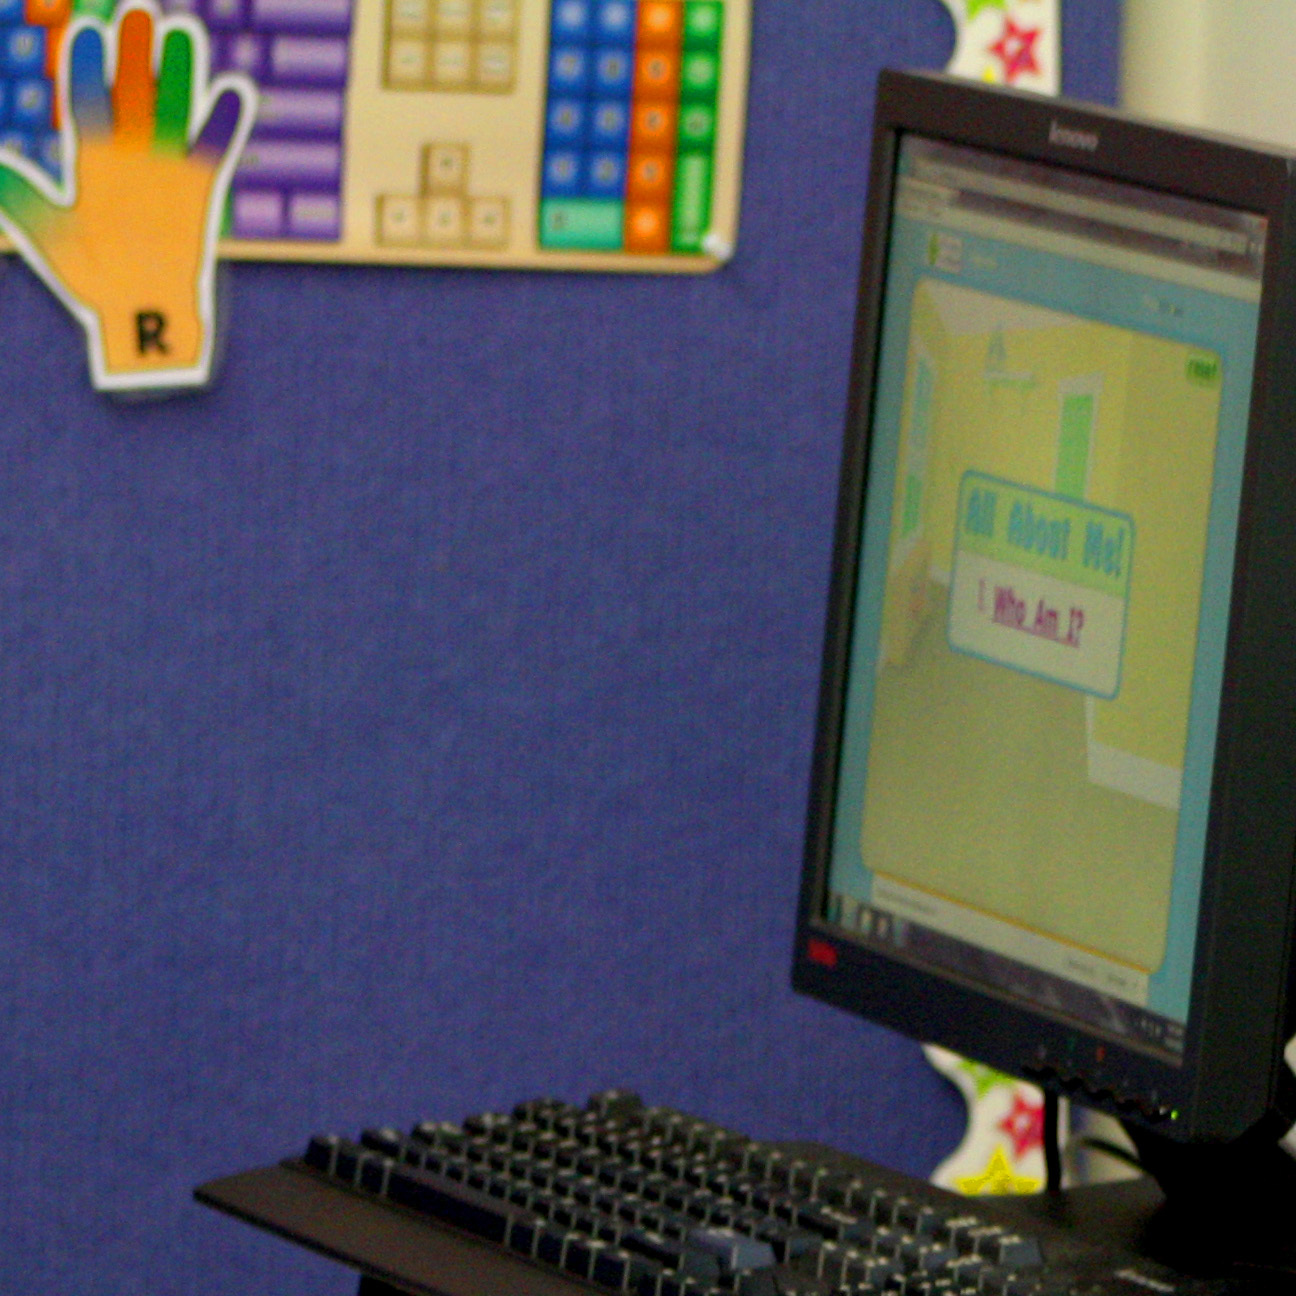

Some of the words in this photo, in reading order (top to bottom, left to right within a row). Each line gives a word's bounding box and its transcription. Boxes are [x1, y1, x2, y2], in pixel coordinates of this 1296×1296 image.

[135, 309, 169, 356] R
[964, 486, 997, 540] All
[1007, 500, 1071, 561] About
[1082, 520, 1125, 577] Me!
[993, 584, 1026, 627] Who
[1034, 597, 1059, 638] Am
